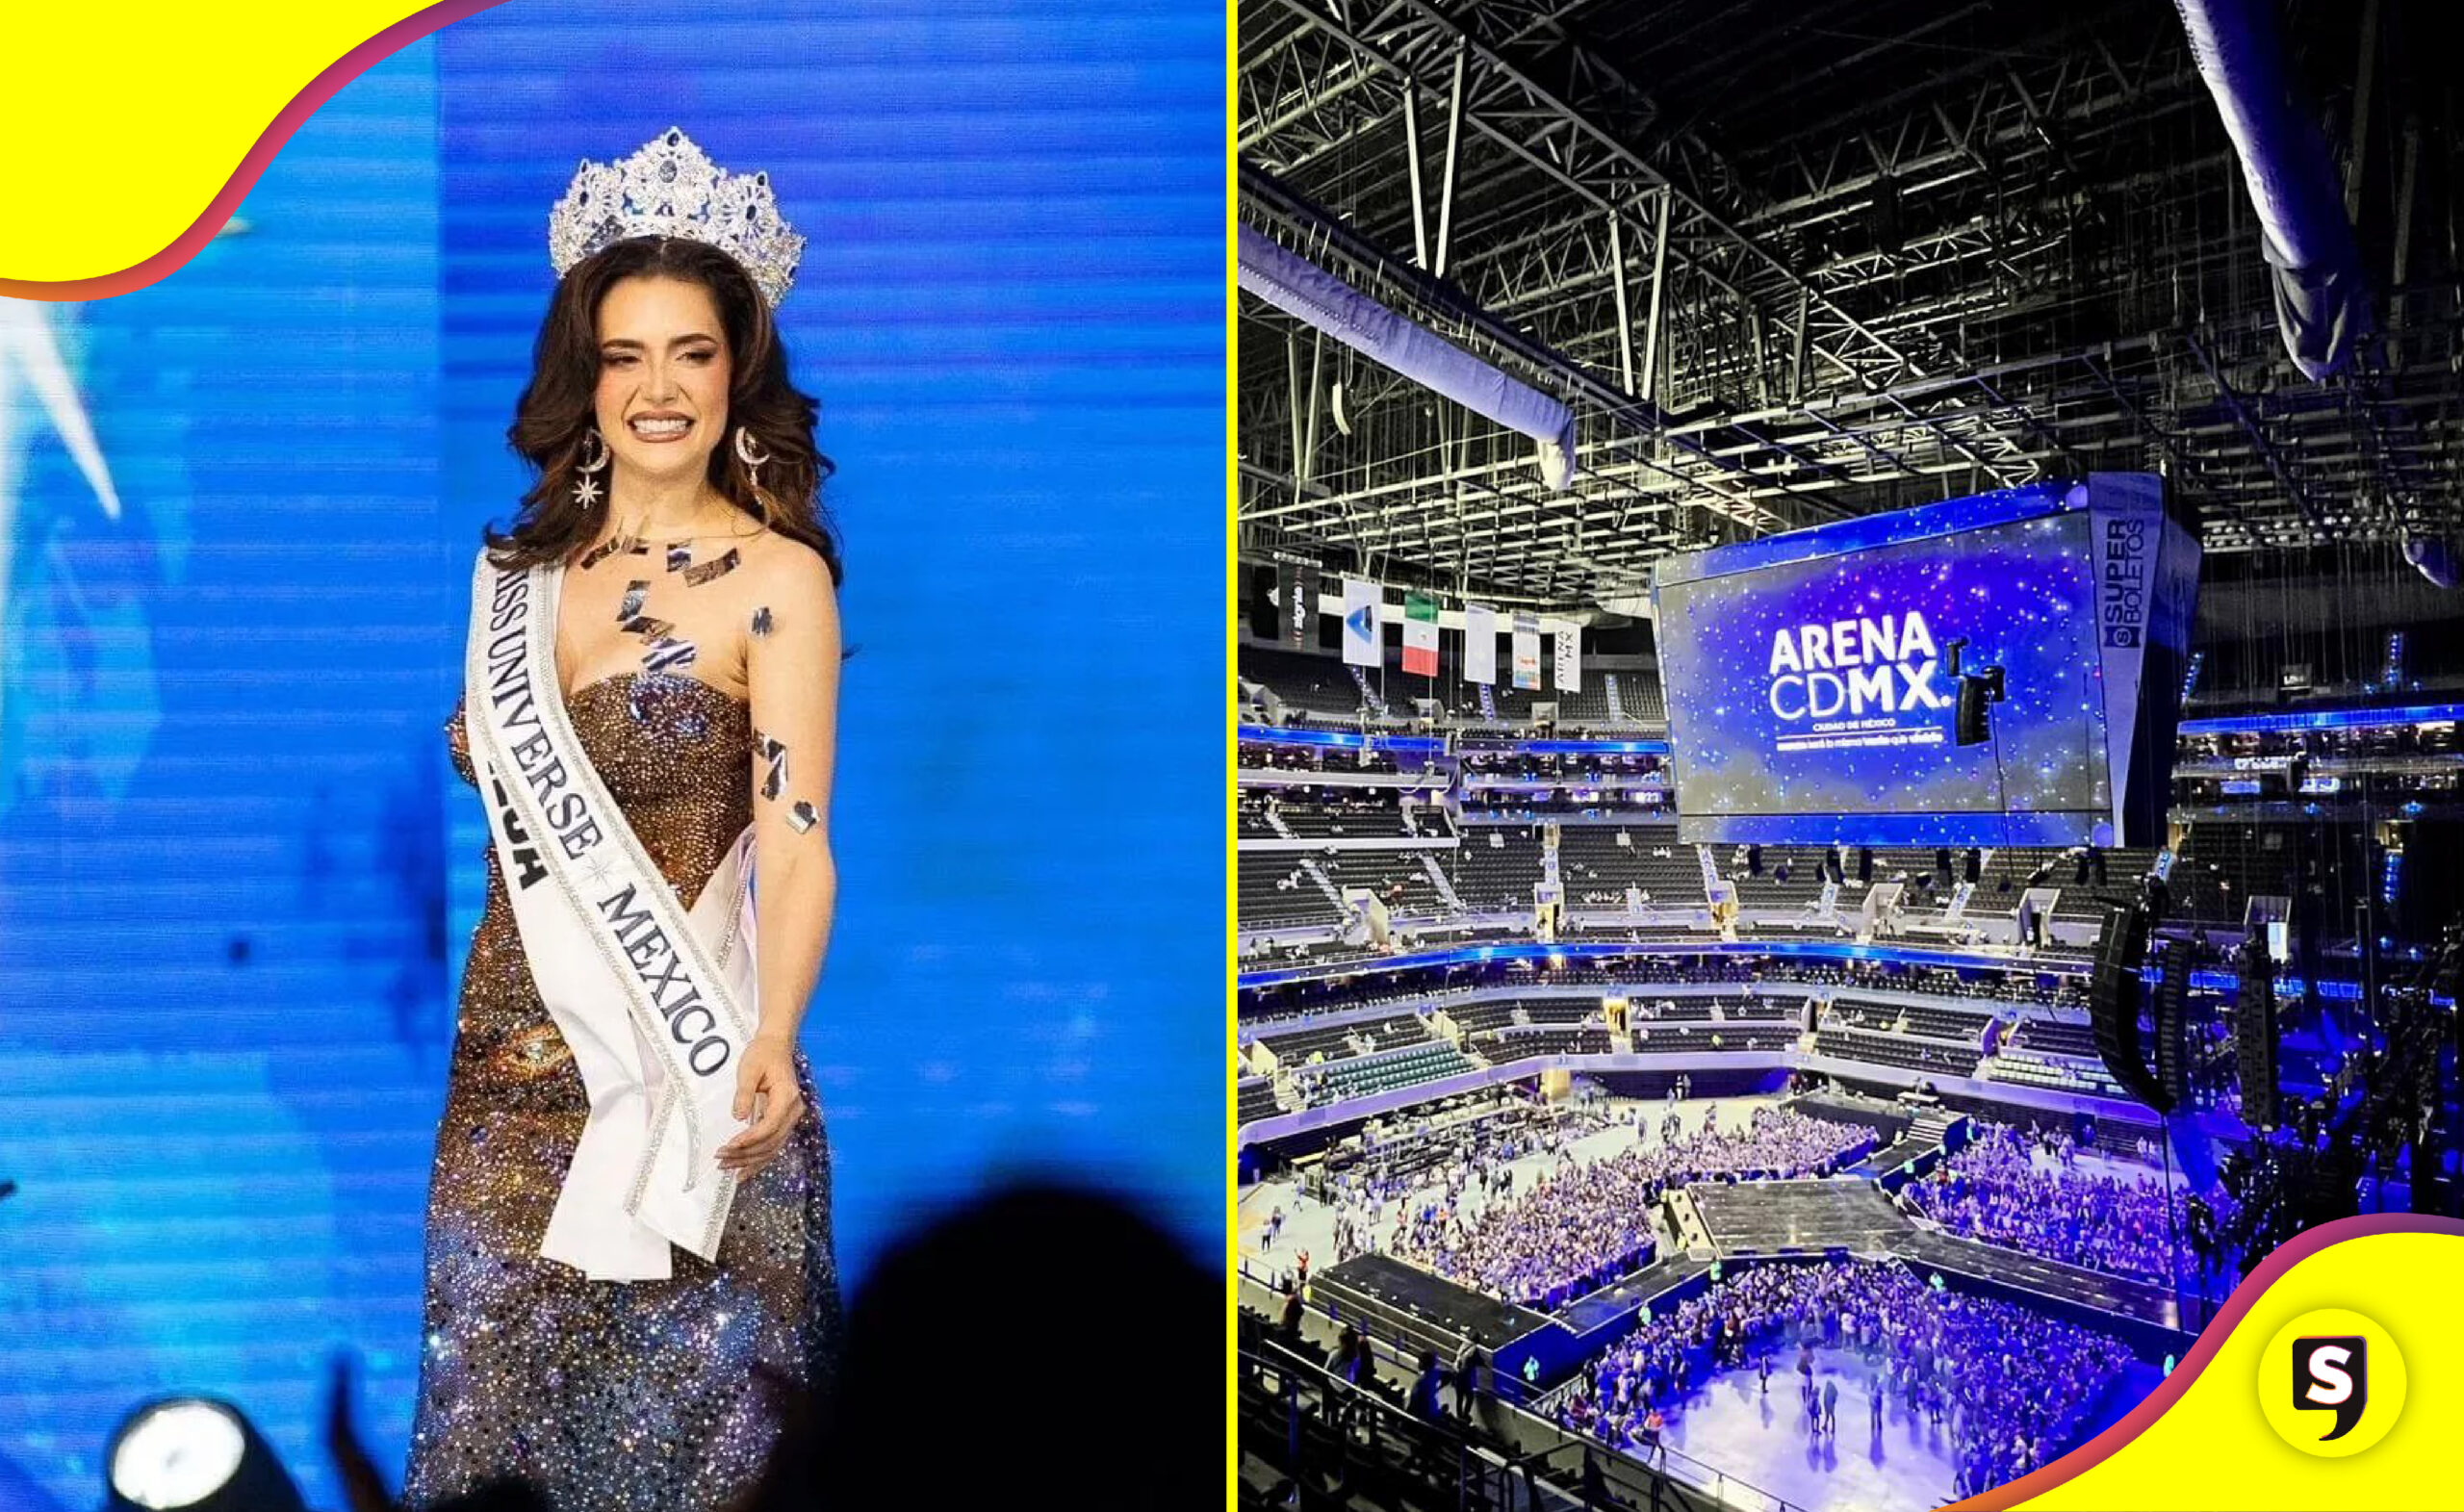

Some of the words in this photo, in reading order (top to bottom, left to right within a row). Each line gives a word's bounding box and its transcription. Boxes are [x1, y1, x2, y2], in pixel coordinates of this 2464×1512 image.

[2104, 519, 2126, 623] SUPER
[2124, 519, 2144, 623] BOLETOS
[1769, 611, 1938, 674] ARENA
[488, 625, 603, 859] UNIVERSE
[596, 883, 731, 1077] MEXICO
